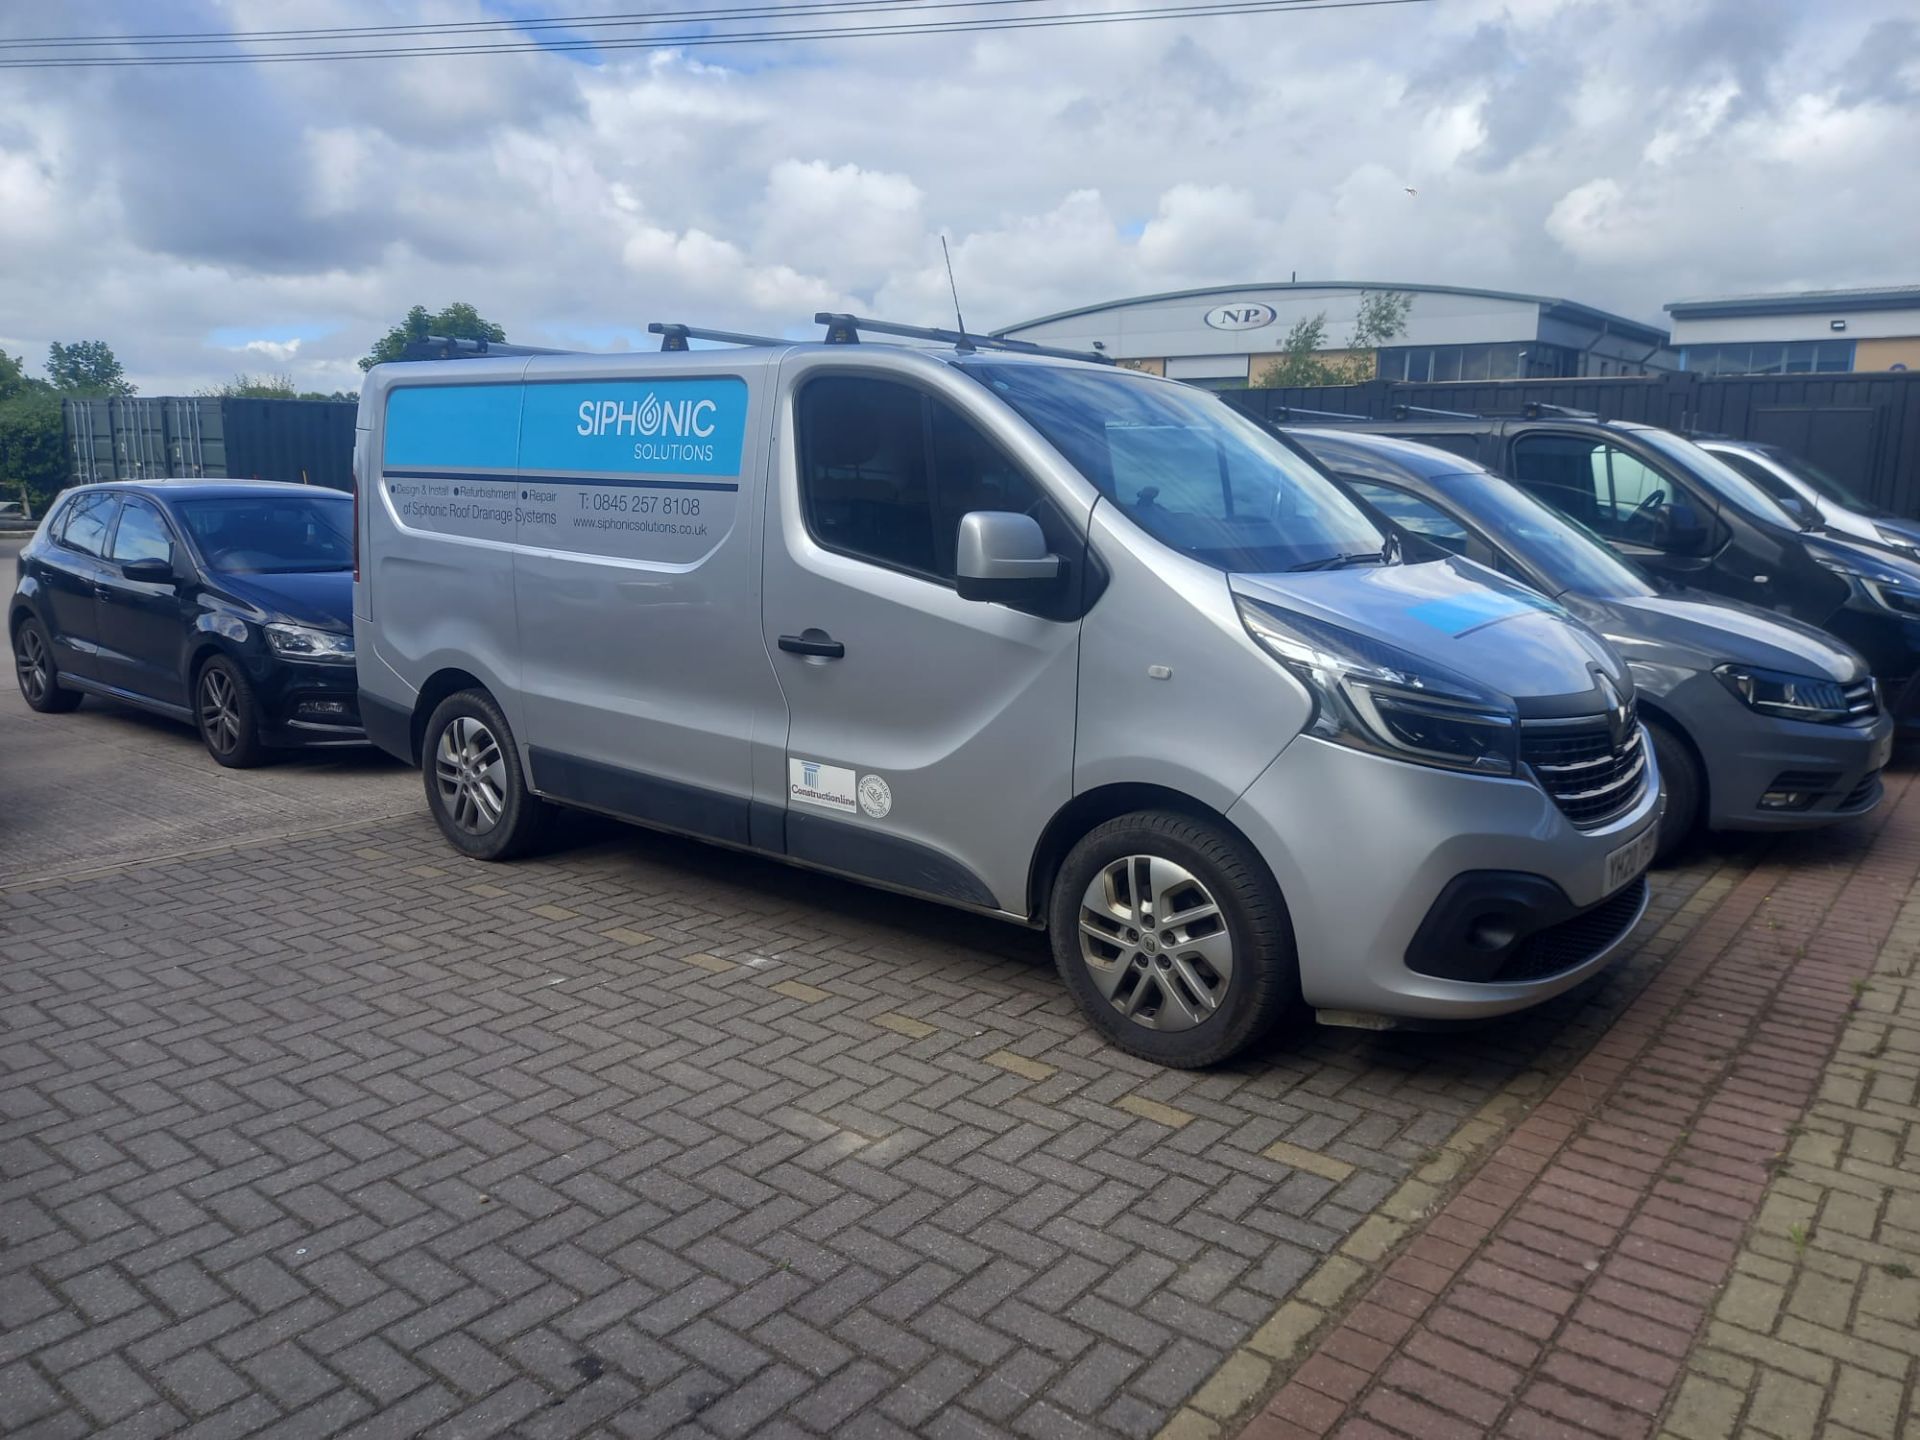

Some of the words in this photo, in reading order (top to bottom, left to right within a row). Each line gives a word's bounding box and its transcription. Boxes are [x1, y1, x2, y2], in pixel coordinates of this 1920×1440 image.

[1221, 309, 1260, 324] NP
[577, 392, 716, 438] SIPHONIC
[634, 443, 713, 462] SOLUTIONS
[397, 485, 419, 496] Design
[421, 485, 427, 495] &
[428, 485, 449, 496] Install
[460, 486, 516, 500] Refurbishment
[529, 490, 557, 502] Repair
[403, 503, 412, 515] of
[412, 503, 447, 518] Siphonic
[450, 504, 471, 518] Roof
[472, 505, 513, 525] Drainage
[516, 508, 557, 526] Systems
[579, 492, 590, 510] T:
[593, 493, 627, 513] 0845
[631, 495, 659, 514] 257
[663, 497, 700, 517] 8108
[573, 516, 708, 537] www.siphonicsolutions.co.uk
[792, 784, 855, 806] Constructionline
